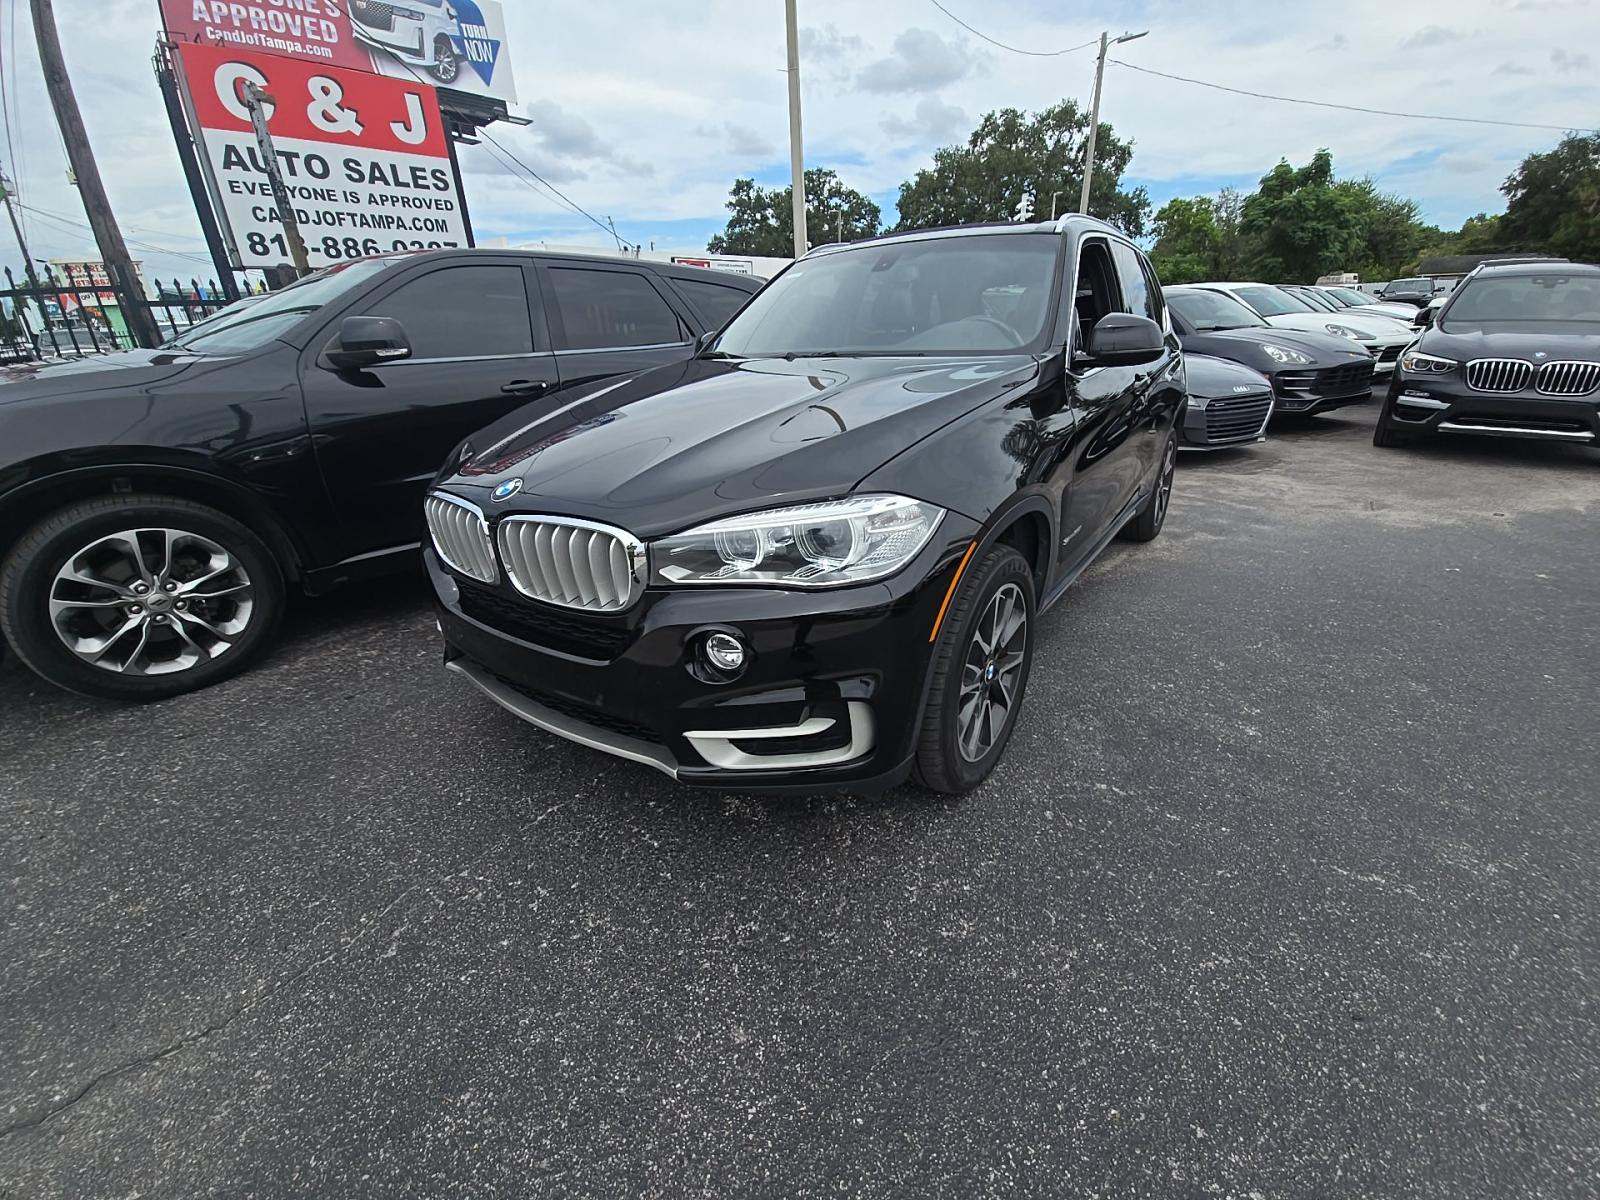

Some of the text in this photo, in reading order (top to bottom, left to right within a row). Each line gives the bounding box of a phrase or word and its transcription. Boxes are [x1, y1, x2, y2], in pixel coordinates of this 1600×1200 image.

[192, 0, 339, 43] APPROVED
[205, 26, 333, 58] CandJofTampa.com
[463, 39, 493, 63] NOW
[213, 61, 428, 145] C & J
[222, 144, 450, 192] AUTO SALES
[227, 180, 454, 211] EVEYONE IS APPROVED
[252, 206, 449, 233] CADJOFTAMPA.COM
